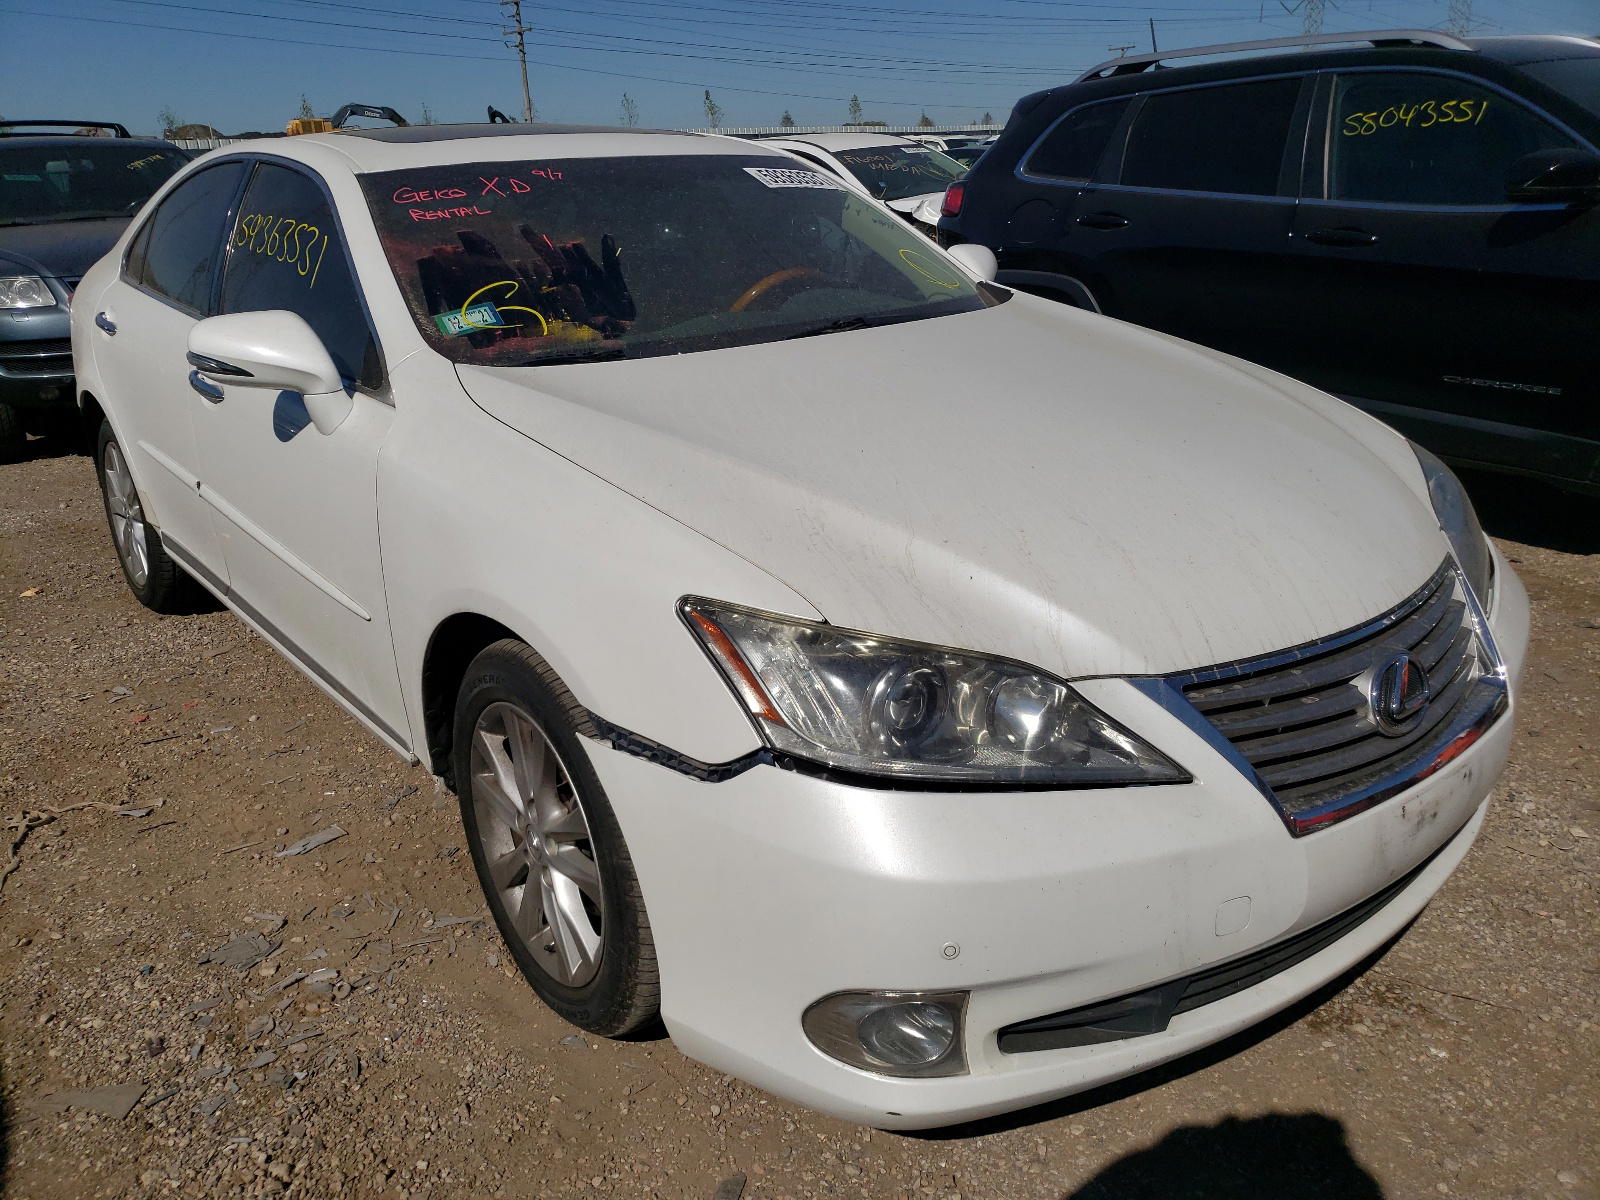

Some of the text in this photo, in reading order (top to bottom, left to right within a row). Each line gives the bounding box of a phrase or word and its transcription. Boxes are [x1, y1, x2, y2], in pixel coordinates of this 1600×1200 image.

[1343, 101, 1487, 136] 58043551
[409, 205, 492, 222] RENTAL
[237, 213, 328, 289] 59363531
